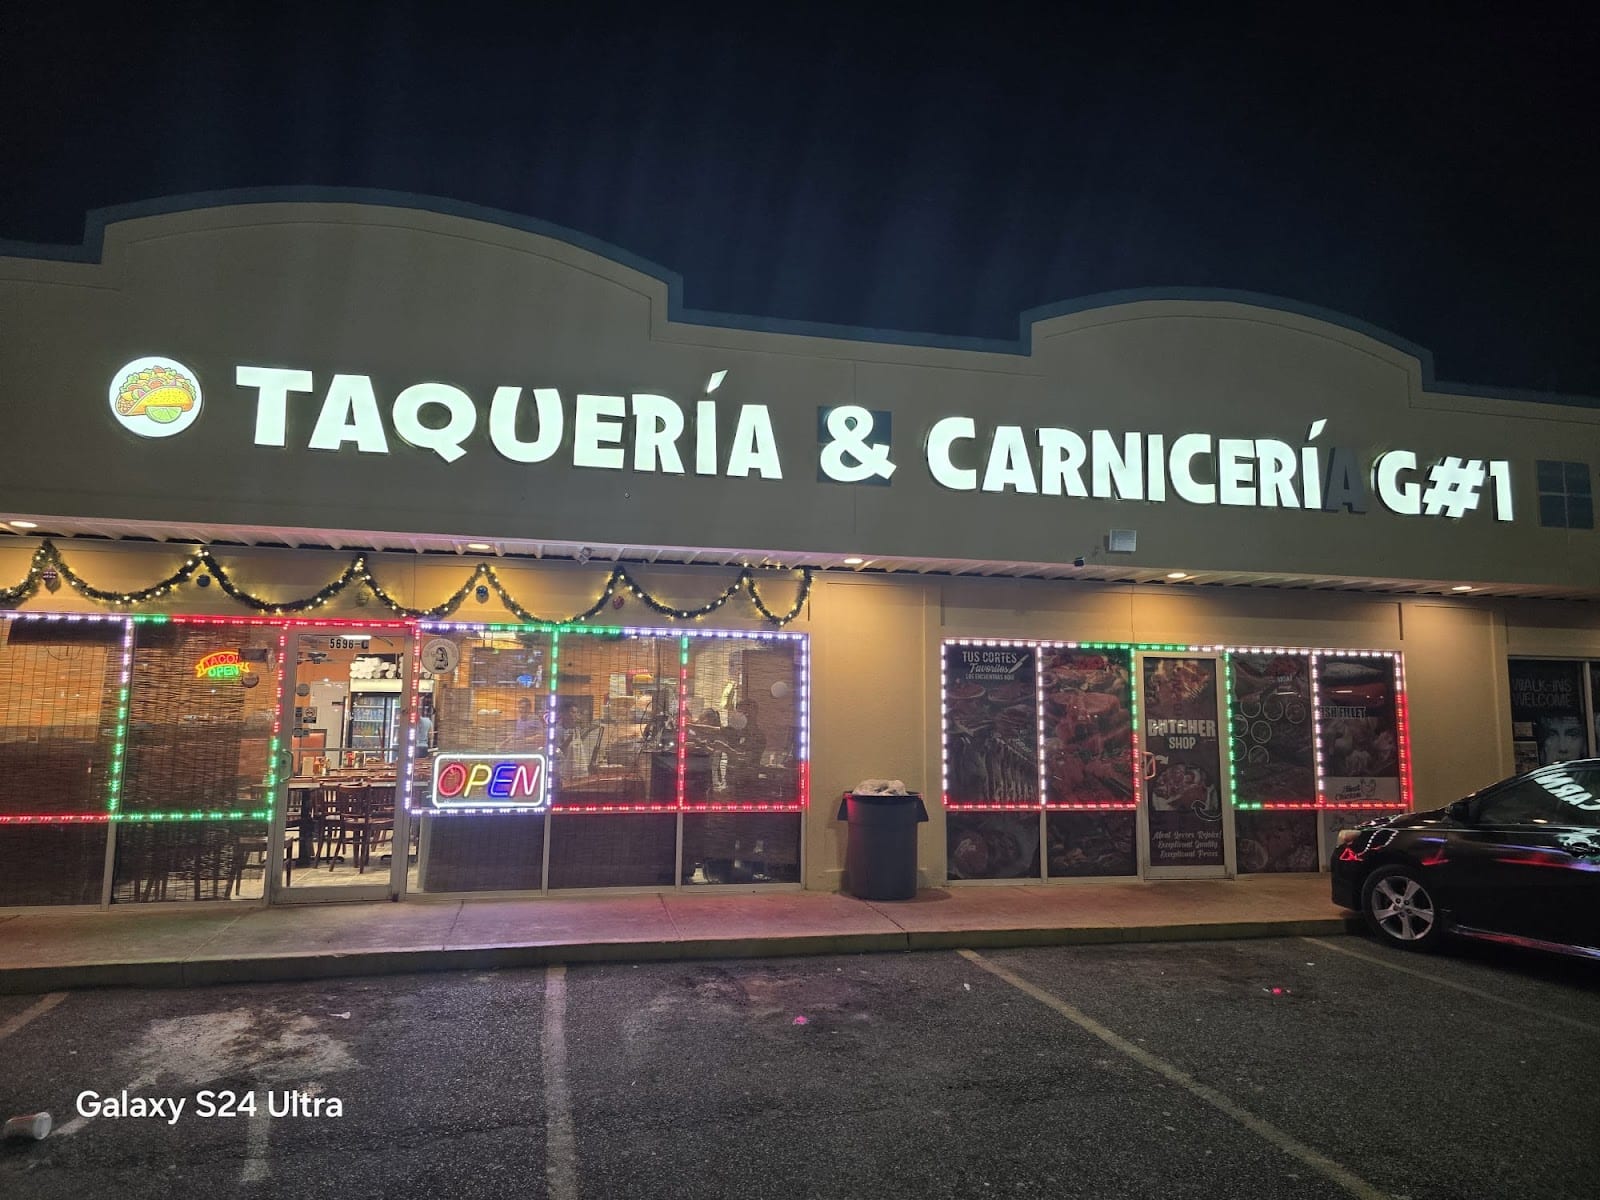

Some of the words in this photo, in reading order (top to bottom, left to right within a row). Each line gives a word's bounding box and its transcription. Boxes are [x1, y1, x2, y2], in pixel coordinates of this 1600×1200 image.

[236, 365, 783, 480] TAQUERÍA
[820, 405, 896, 483] &
[926, 418, 1366, 514] CARNICERÍA
[1378, 450, 1514, 521] G#1
[962, 651, 980, 663] TUS
[982, 651, 1017, 664] CORTES
[207, 665, 239, 678] OPEN
[1318, 705, 1337, 719] ISH
[1147, 719, 1217, 737] BUTCHER
[1168, 737, 1197, 750] SHOP
[438, 763, 541, 798] OPEN
